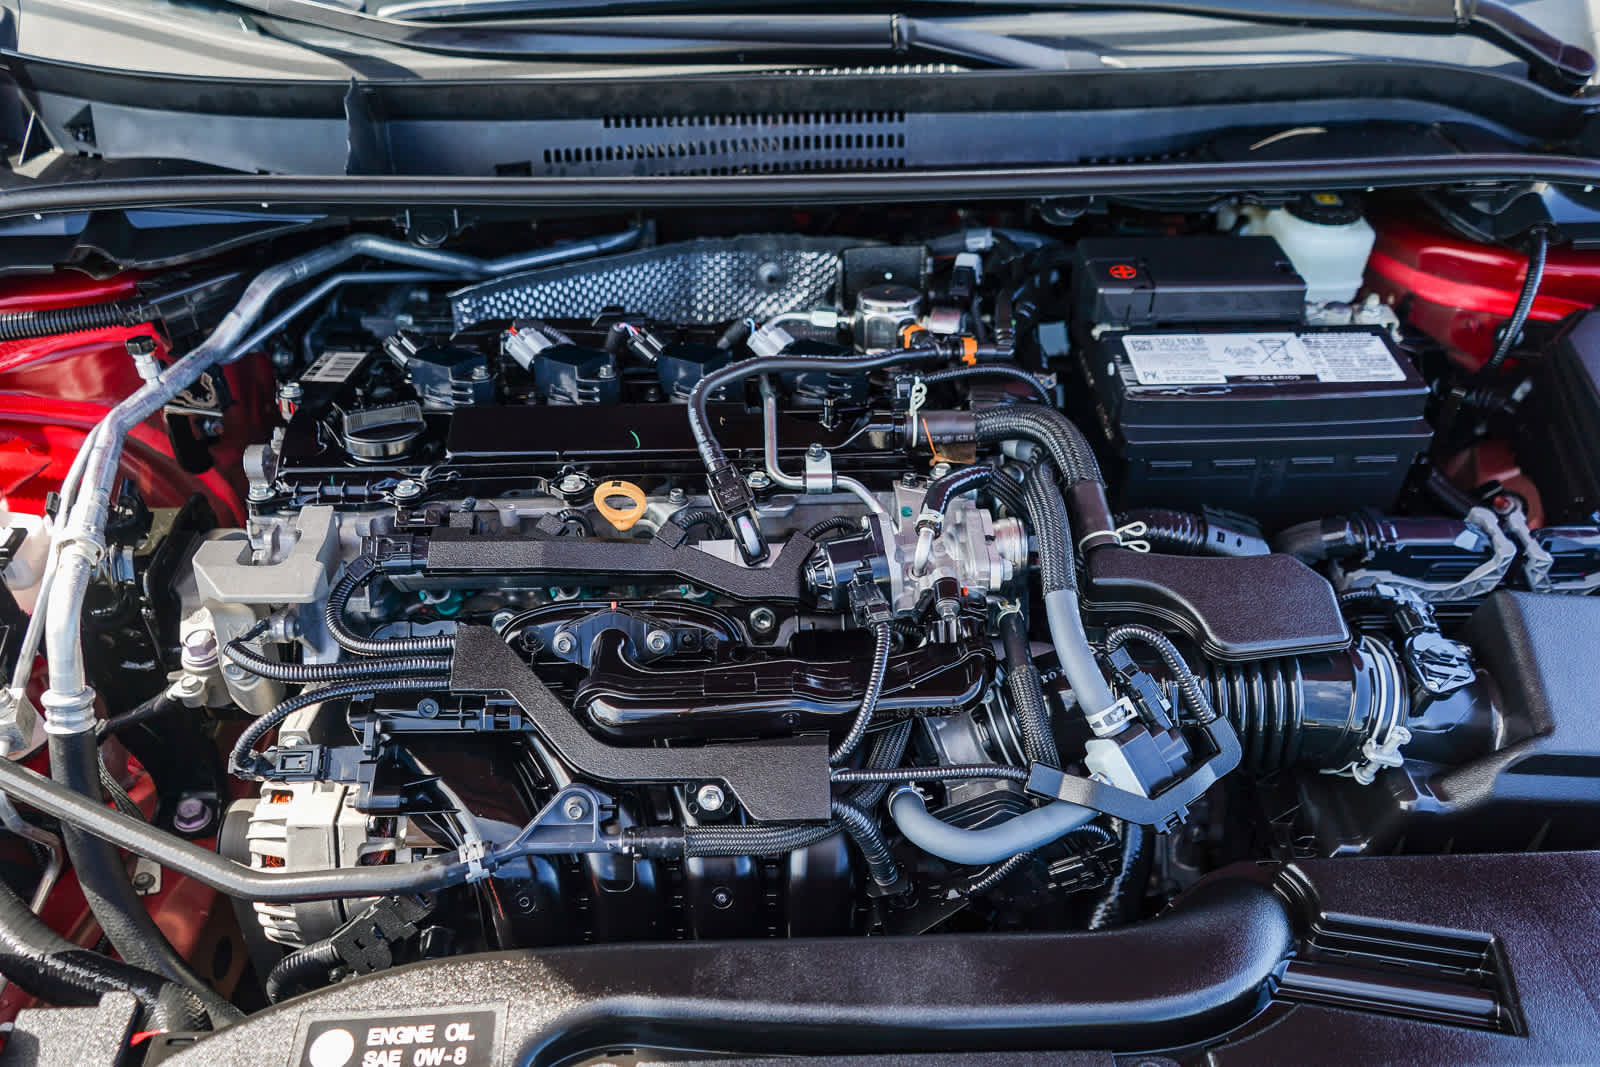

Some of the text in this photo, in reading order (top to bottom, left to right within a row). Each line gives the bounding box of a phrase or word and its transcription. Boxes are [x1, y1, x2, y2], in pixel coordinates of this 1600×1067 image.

[367, 1023, 475, 1046] ENGINE OIL
[362, 1047, 467, 1067] SAE 0W-8
